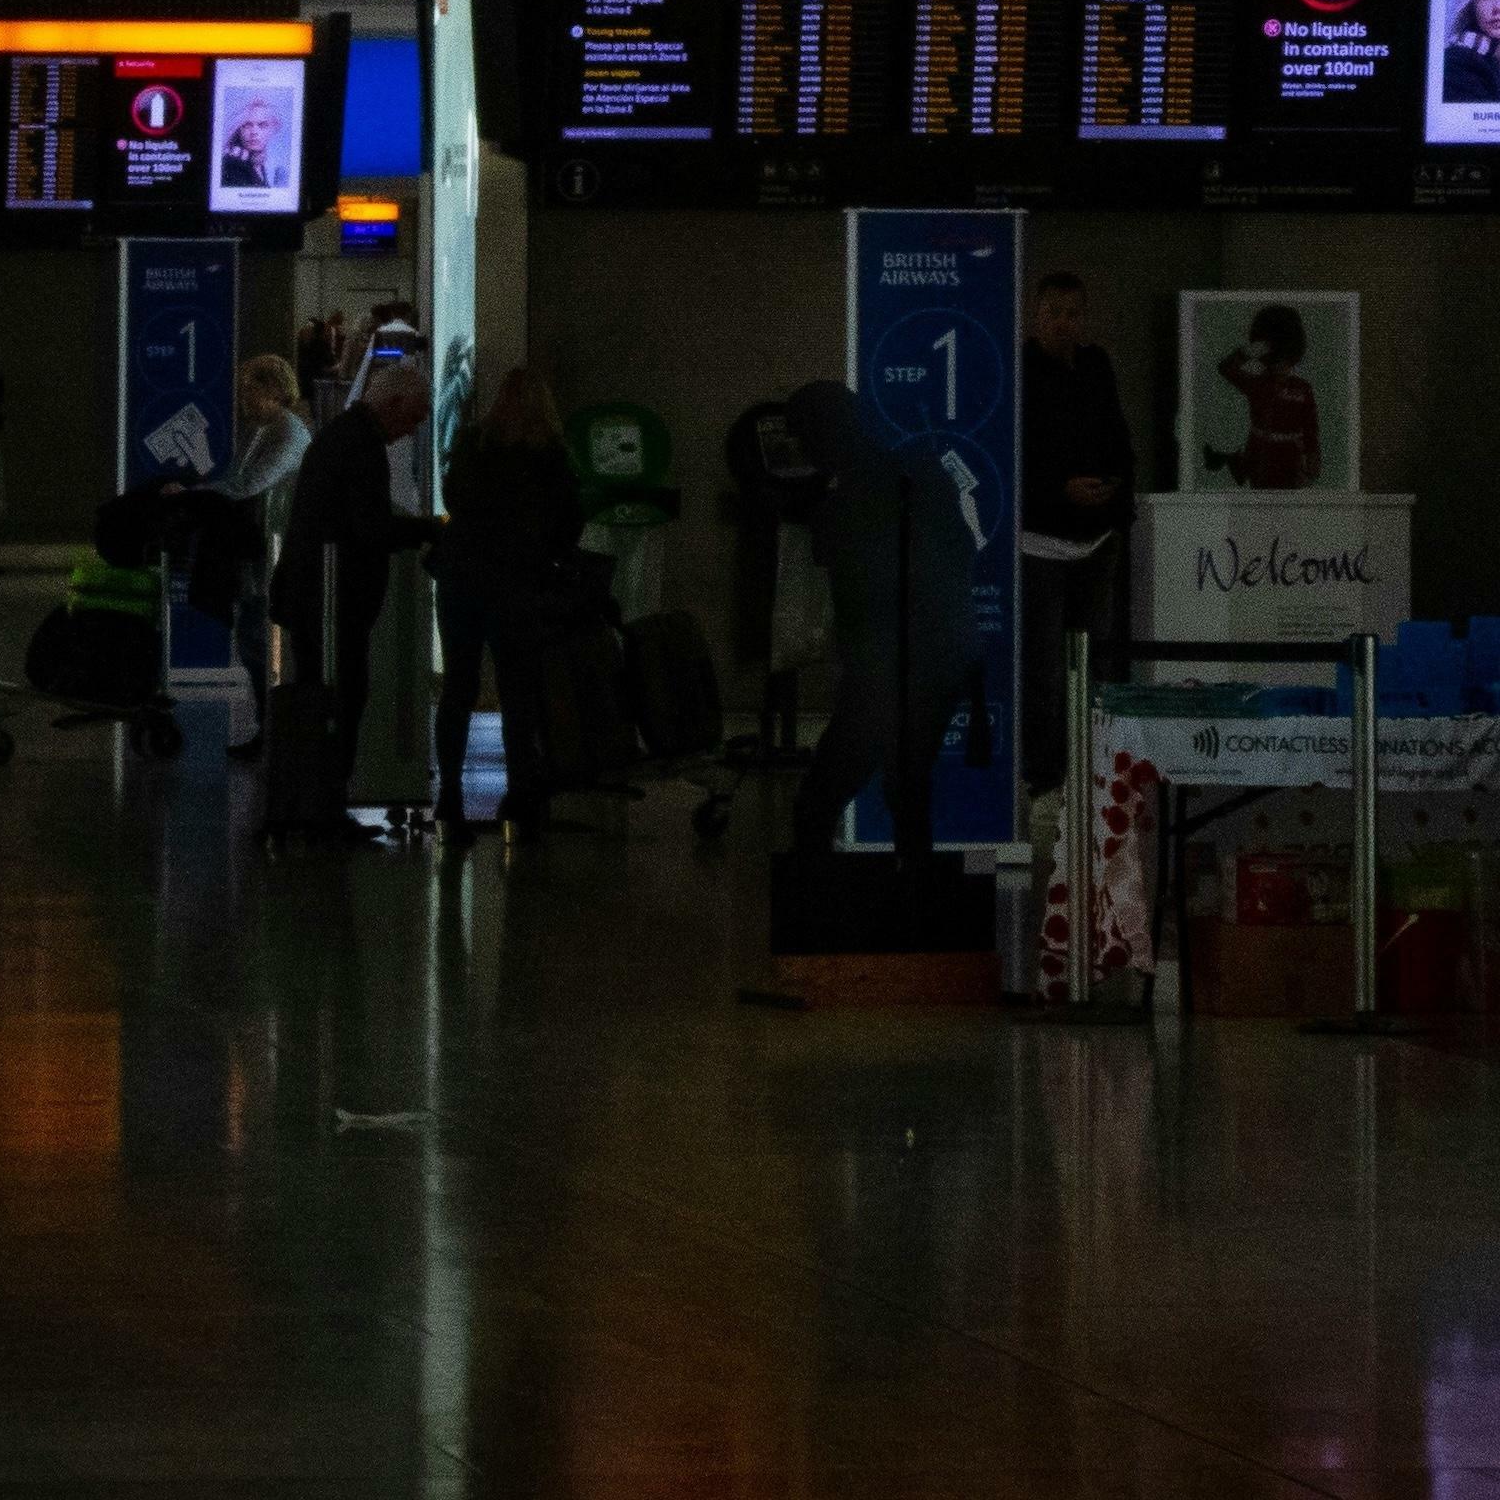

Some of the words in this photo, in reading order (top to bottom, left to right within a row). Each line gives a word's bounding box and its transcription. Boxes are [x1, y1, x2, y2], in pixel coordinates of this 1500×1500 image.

[1284, 21, 1308, 38] No
[1311, 21, 1368, 40] liquids
[1283, 41, 1301, 57] in
[1302, 41, 1391, 57] containers
[1282, 63, 1322, 76] over
[1323, 60, 1375, 76] 100ml
[882, 252, 957, 269] BRITISH
[879, 270, 962, 287] AIRWAYS
[180, 320, 196, 384] 1
[884, 366, 927, 383] STEP
[932, 328, 957, 421] 1
[1198, 536, 1379, 592] Welcome
[1224, 734, 1349, 755] CONTACTLESS
